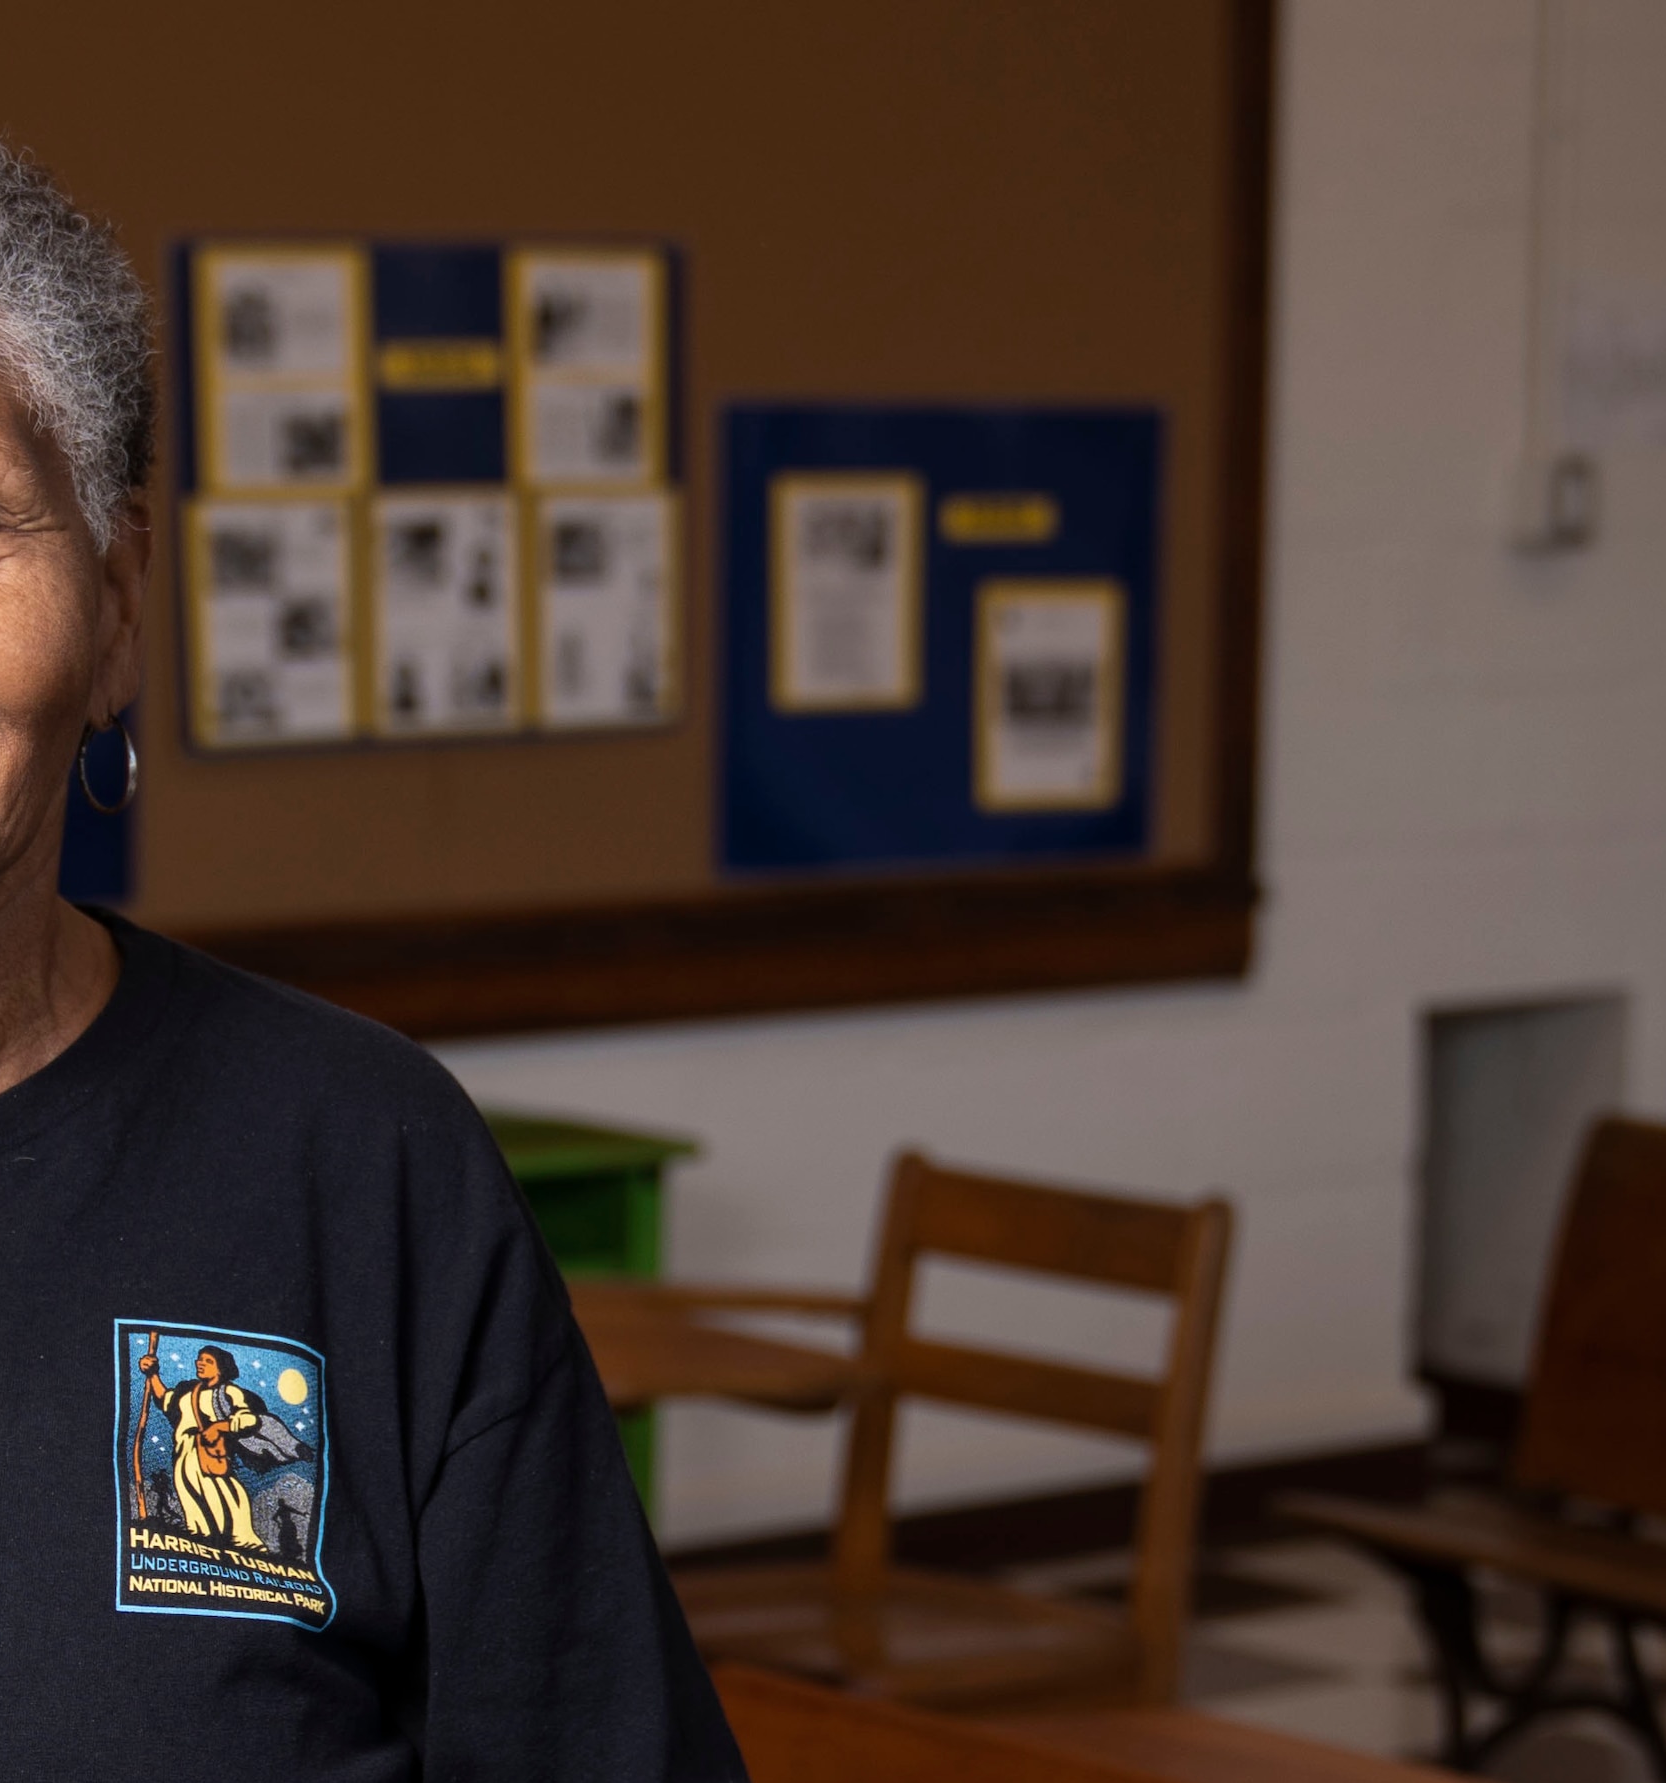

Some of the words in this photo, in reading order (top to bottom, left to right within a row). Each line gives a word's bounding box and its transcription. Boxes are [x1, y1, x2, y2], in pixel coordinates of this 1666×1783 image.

[129, 1527, 221, 1561] HARRIET
[224, 1549, 316, 1582] TUBMAN
[130, 1553, 250, 1582] UNDERGROUND
[253, 1572, 323, 1595] RAILROAD
[129, 1575, 207, 1596] NATIONAL
[209, 1580, 293, 1605] HISTORICAL
[295, 1593, 326, 1615] PARK
